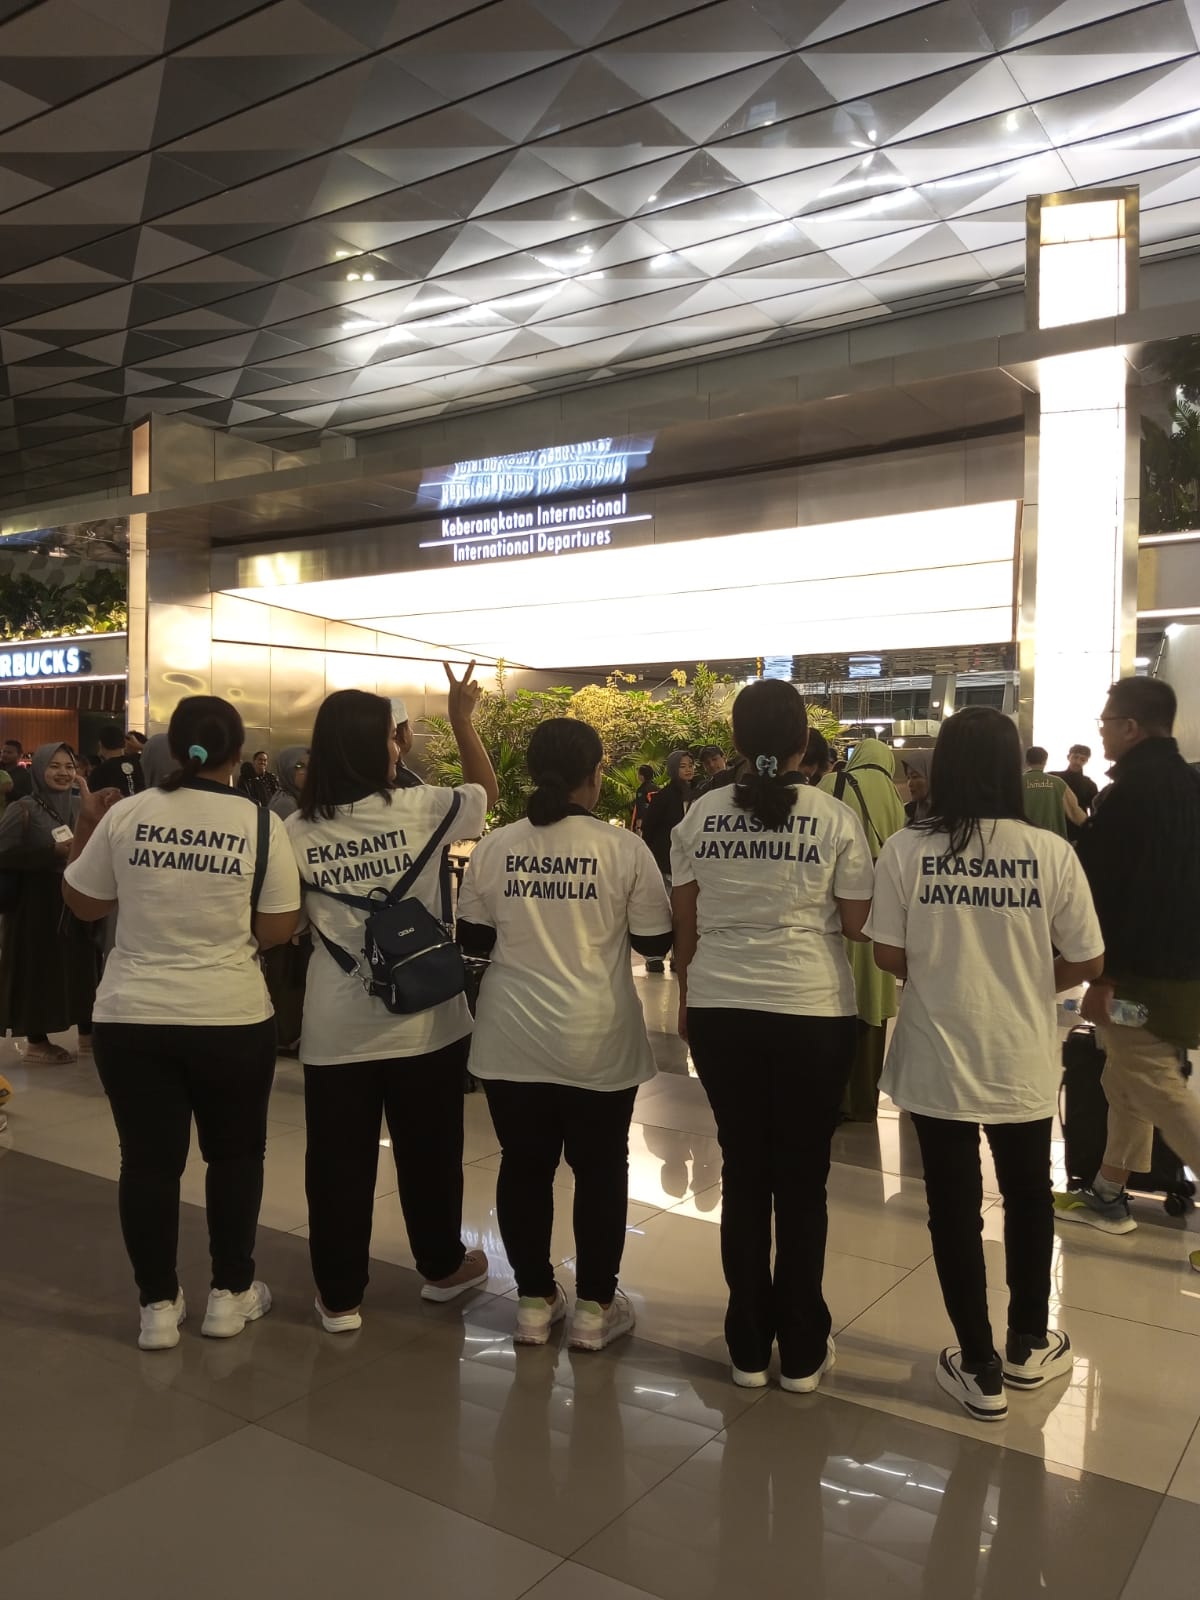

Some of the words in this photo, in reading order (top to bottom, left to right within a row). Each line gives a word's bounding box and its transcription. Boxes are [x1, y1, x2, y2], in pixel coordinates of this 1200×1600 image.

[441, 510, 533, 538] Keberangkatan
[537, 493, 626, 526] Internasional
[453, 535, 534, 562] International
[538, 529, 611, 554] Departures
[135, 824, 246, 854] EKASANTI
[306, 830, 407, 864] EKASANTI
[695, 840, 821, 864] JAYAMULIA
[128, 848, 242, 876] JAYAMULIA
[506, 855, 598, 875] EKASANTI
[922, 856, 1039, 879] EKASANTI
[504, 879, 598, 899] JAYAMULIA
[919, 884, 1042, 908] JAYAMULIA
